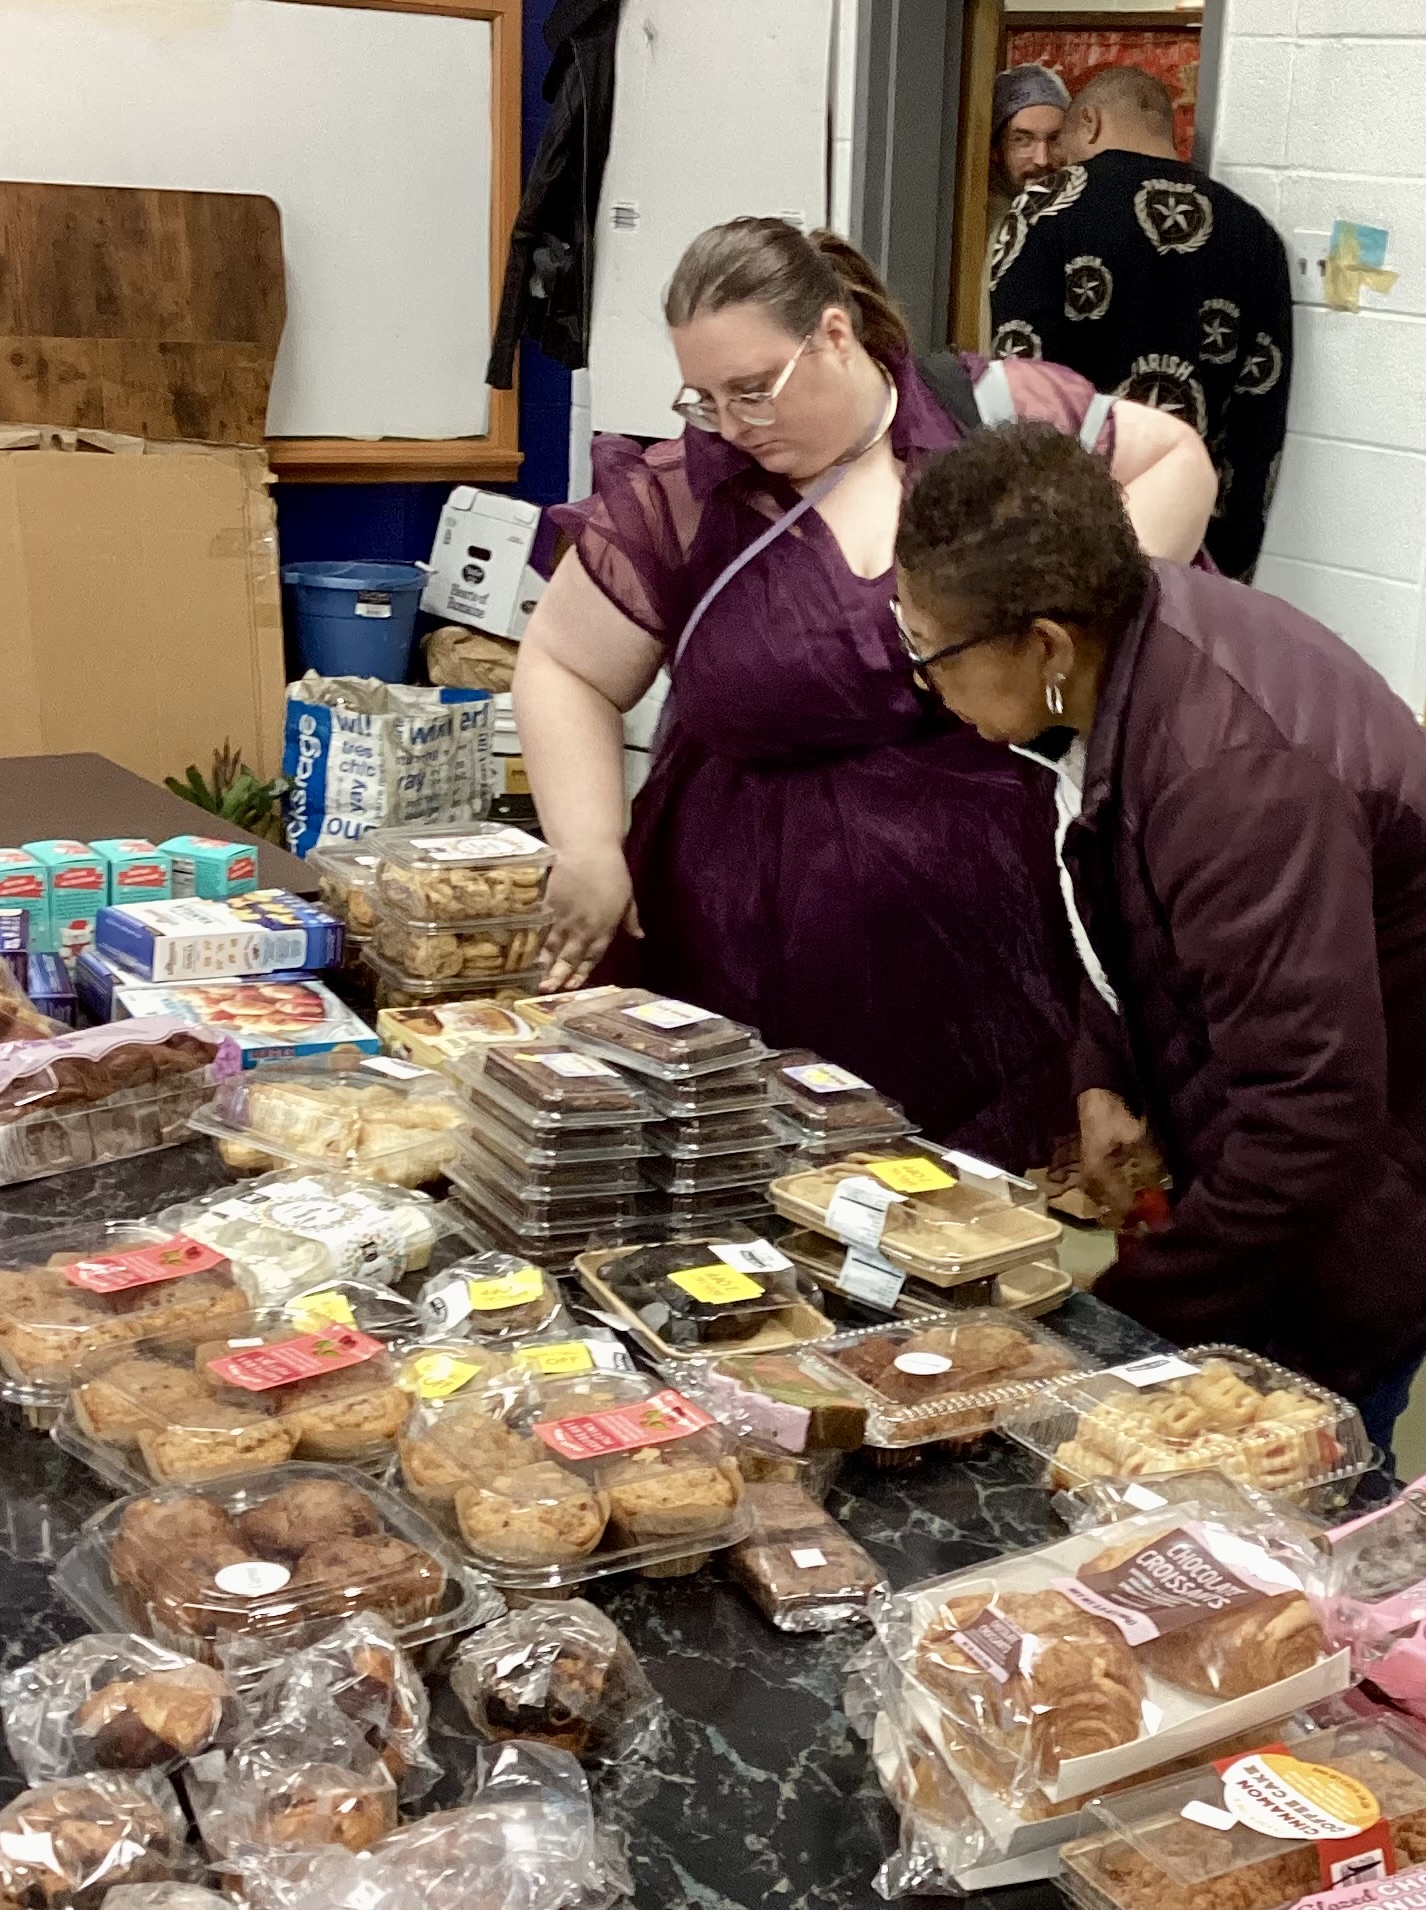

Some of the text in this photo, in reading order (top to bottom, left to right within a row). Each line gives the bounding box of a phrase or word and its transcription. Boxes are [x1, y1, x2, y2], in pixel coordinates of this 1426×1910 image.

[1243, 1764, 1288, 1798] CAKE
[1236, 1779, 1319, 1836] CINNAMON
[1284, 1799, 1346, 1833] COFFEE
